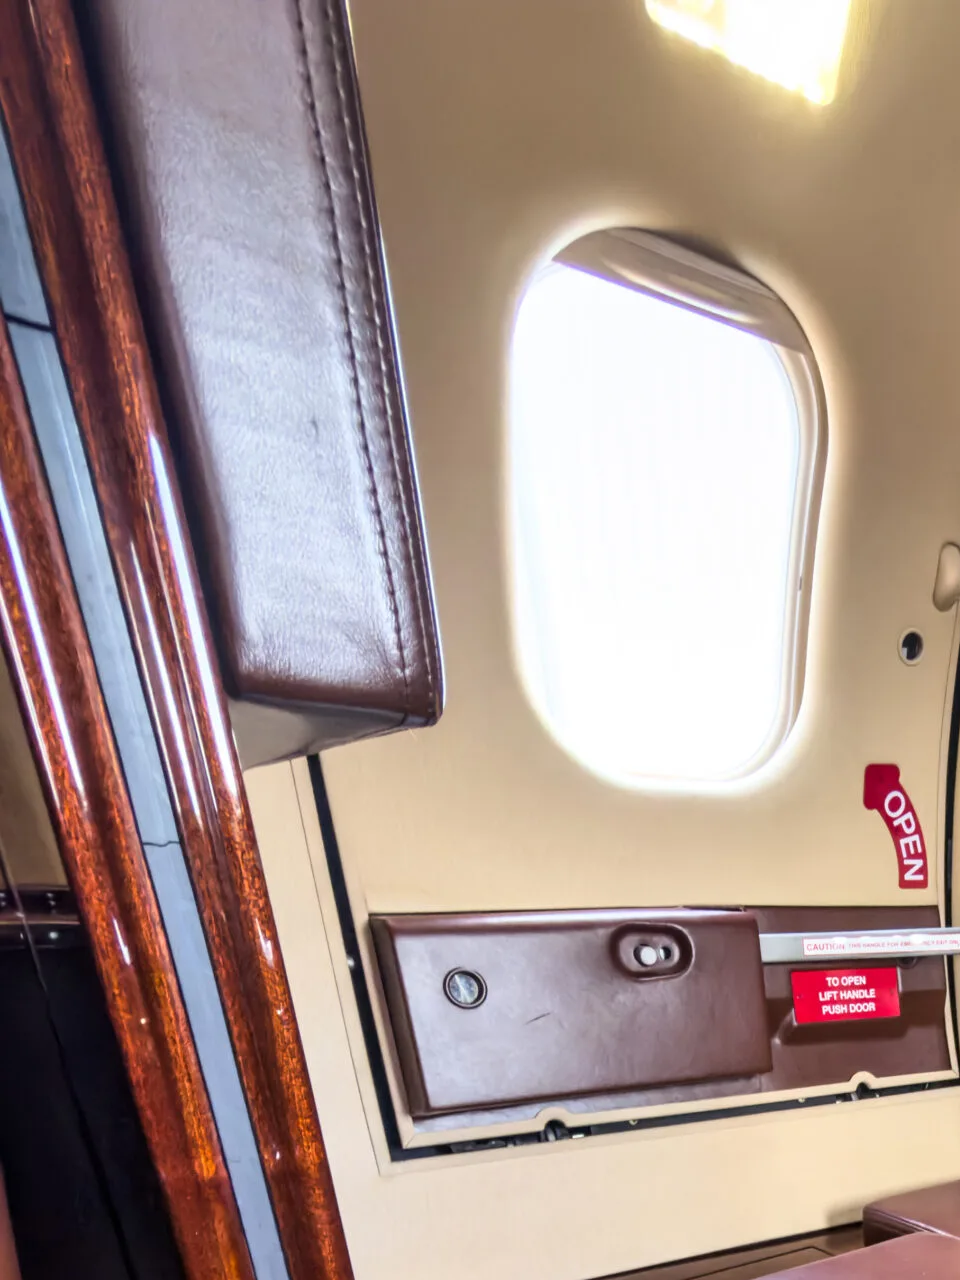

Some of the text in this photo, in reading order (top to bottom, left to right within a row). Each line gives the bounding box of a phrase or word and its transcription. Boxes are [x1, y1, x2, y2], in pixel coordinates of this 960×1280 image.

[883, 790, 924, 881] OPEN
[806, 942, 845, 952] CAUTION
[826, 975, 866, 987] TO OPEN
[819, 988, 876, 1001] LIFT HANDLE
[822, 1002, 876, 1015] PUSH DOOR
